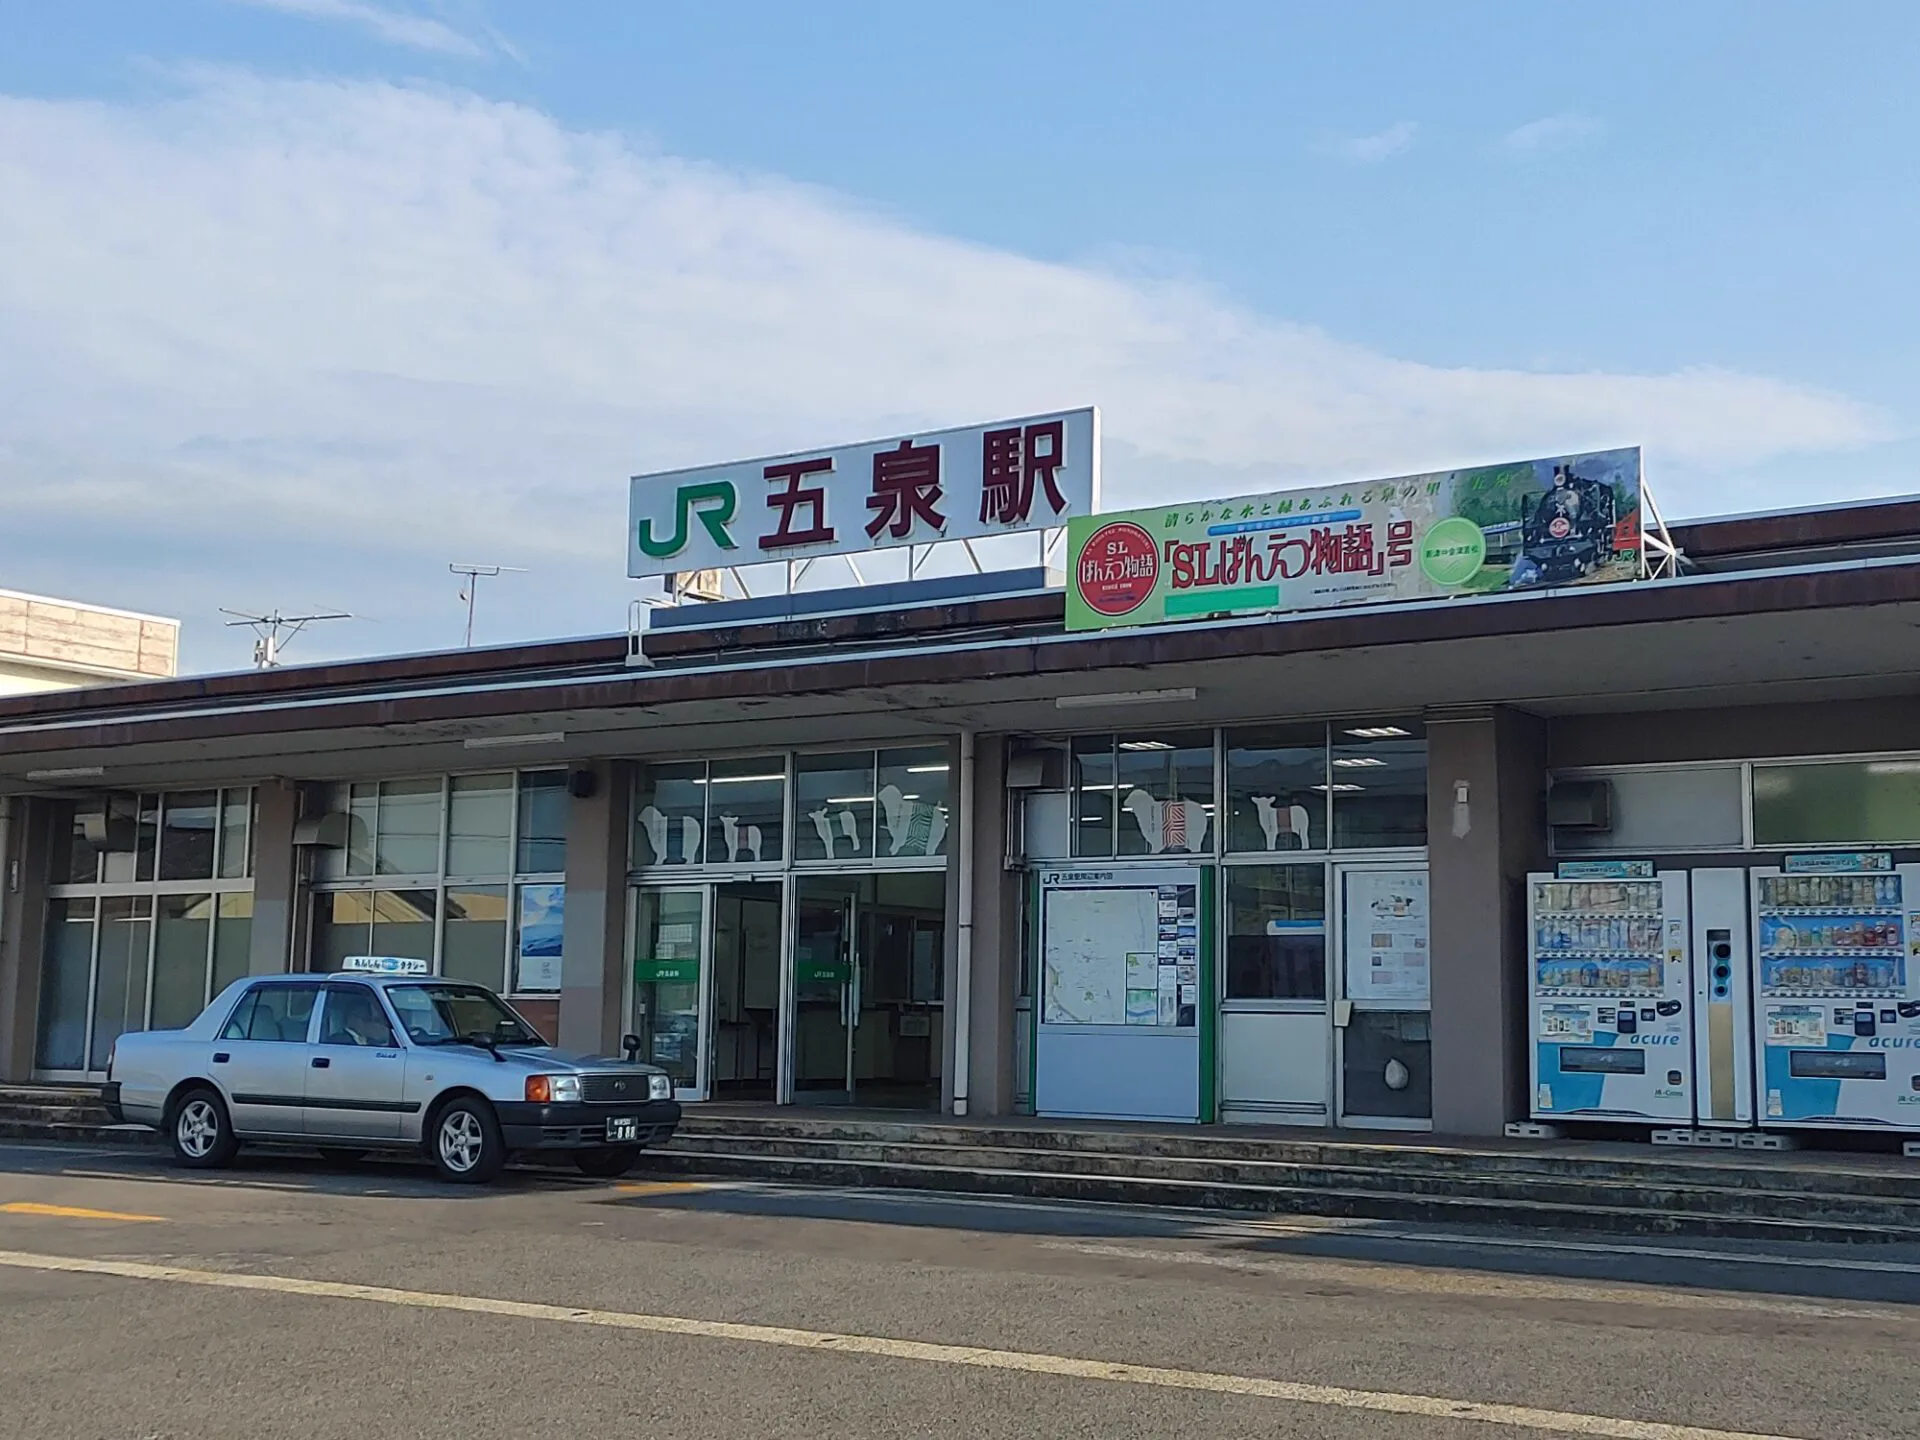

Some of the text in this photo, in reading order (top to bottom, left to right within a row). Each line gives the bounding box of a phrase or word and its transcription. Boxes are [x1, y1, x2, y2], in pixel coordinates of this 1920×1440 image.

[638, 420, 1069, 558] JR 五泉駅
[1107, 541, 1128, 555] SL
[1615, 549, 1635, 562] JR
[1082, 554, 1154, 584] ばんえつ物語
[1043, 873, 1060, 884] JR
[1630, 1034, 1680, 1046] acure
